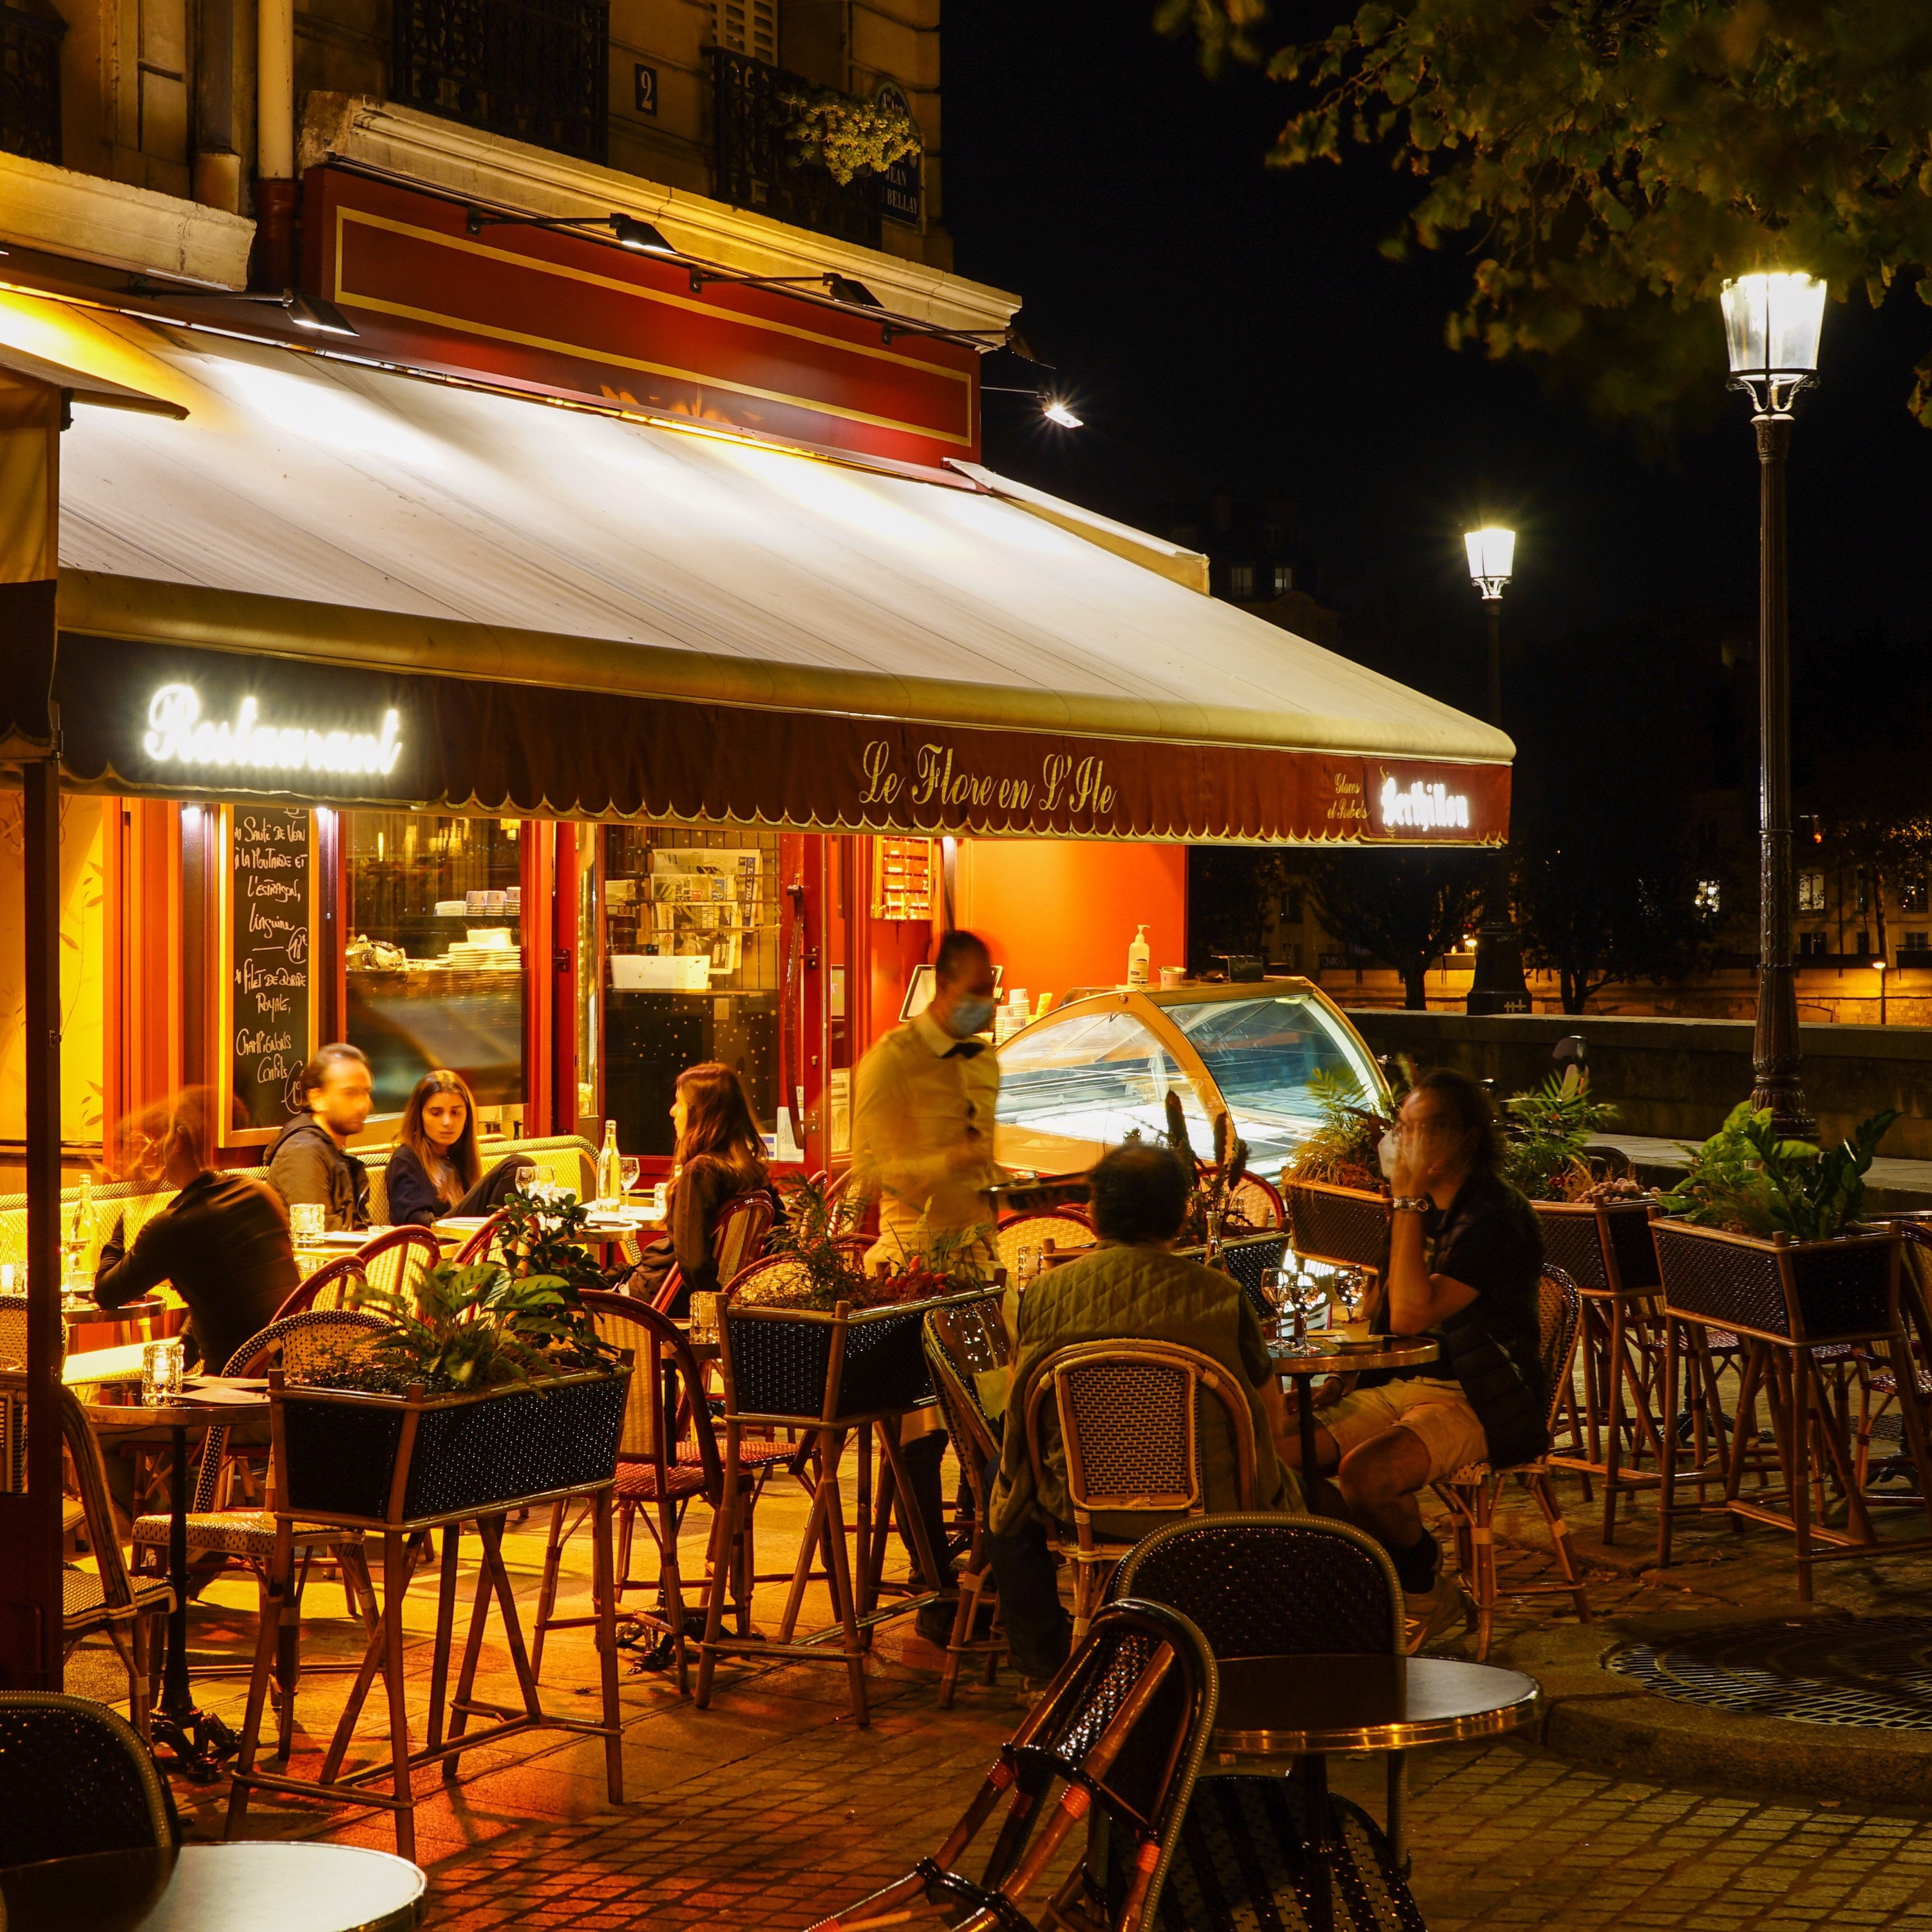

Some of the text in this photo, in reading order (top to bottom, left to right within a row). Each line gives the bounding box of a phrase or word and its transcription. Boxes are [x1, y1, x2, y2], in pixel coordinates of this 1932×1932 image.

[641, 70, 652, 111] 2
[886, 166, 907, 187] JEAN
[887, 188, 918, 214] BELLAY
[144, 683, 402, 774] Restaurant
[858, 741, 905, 804] Le
[911, 743, 998, 806] Flore
[998, 774, 1035, 810] en
[1334, 773, 1361, 794] Glaces
[1327, 798, 1371, 819] et Sorbets
